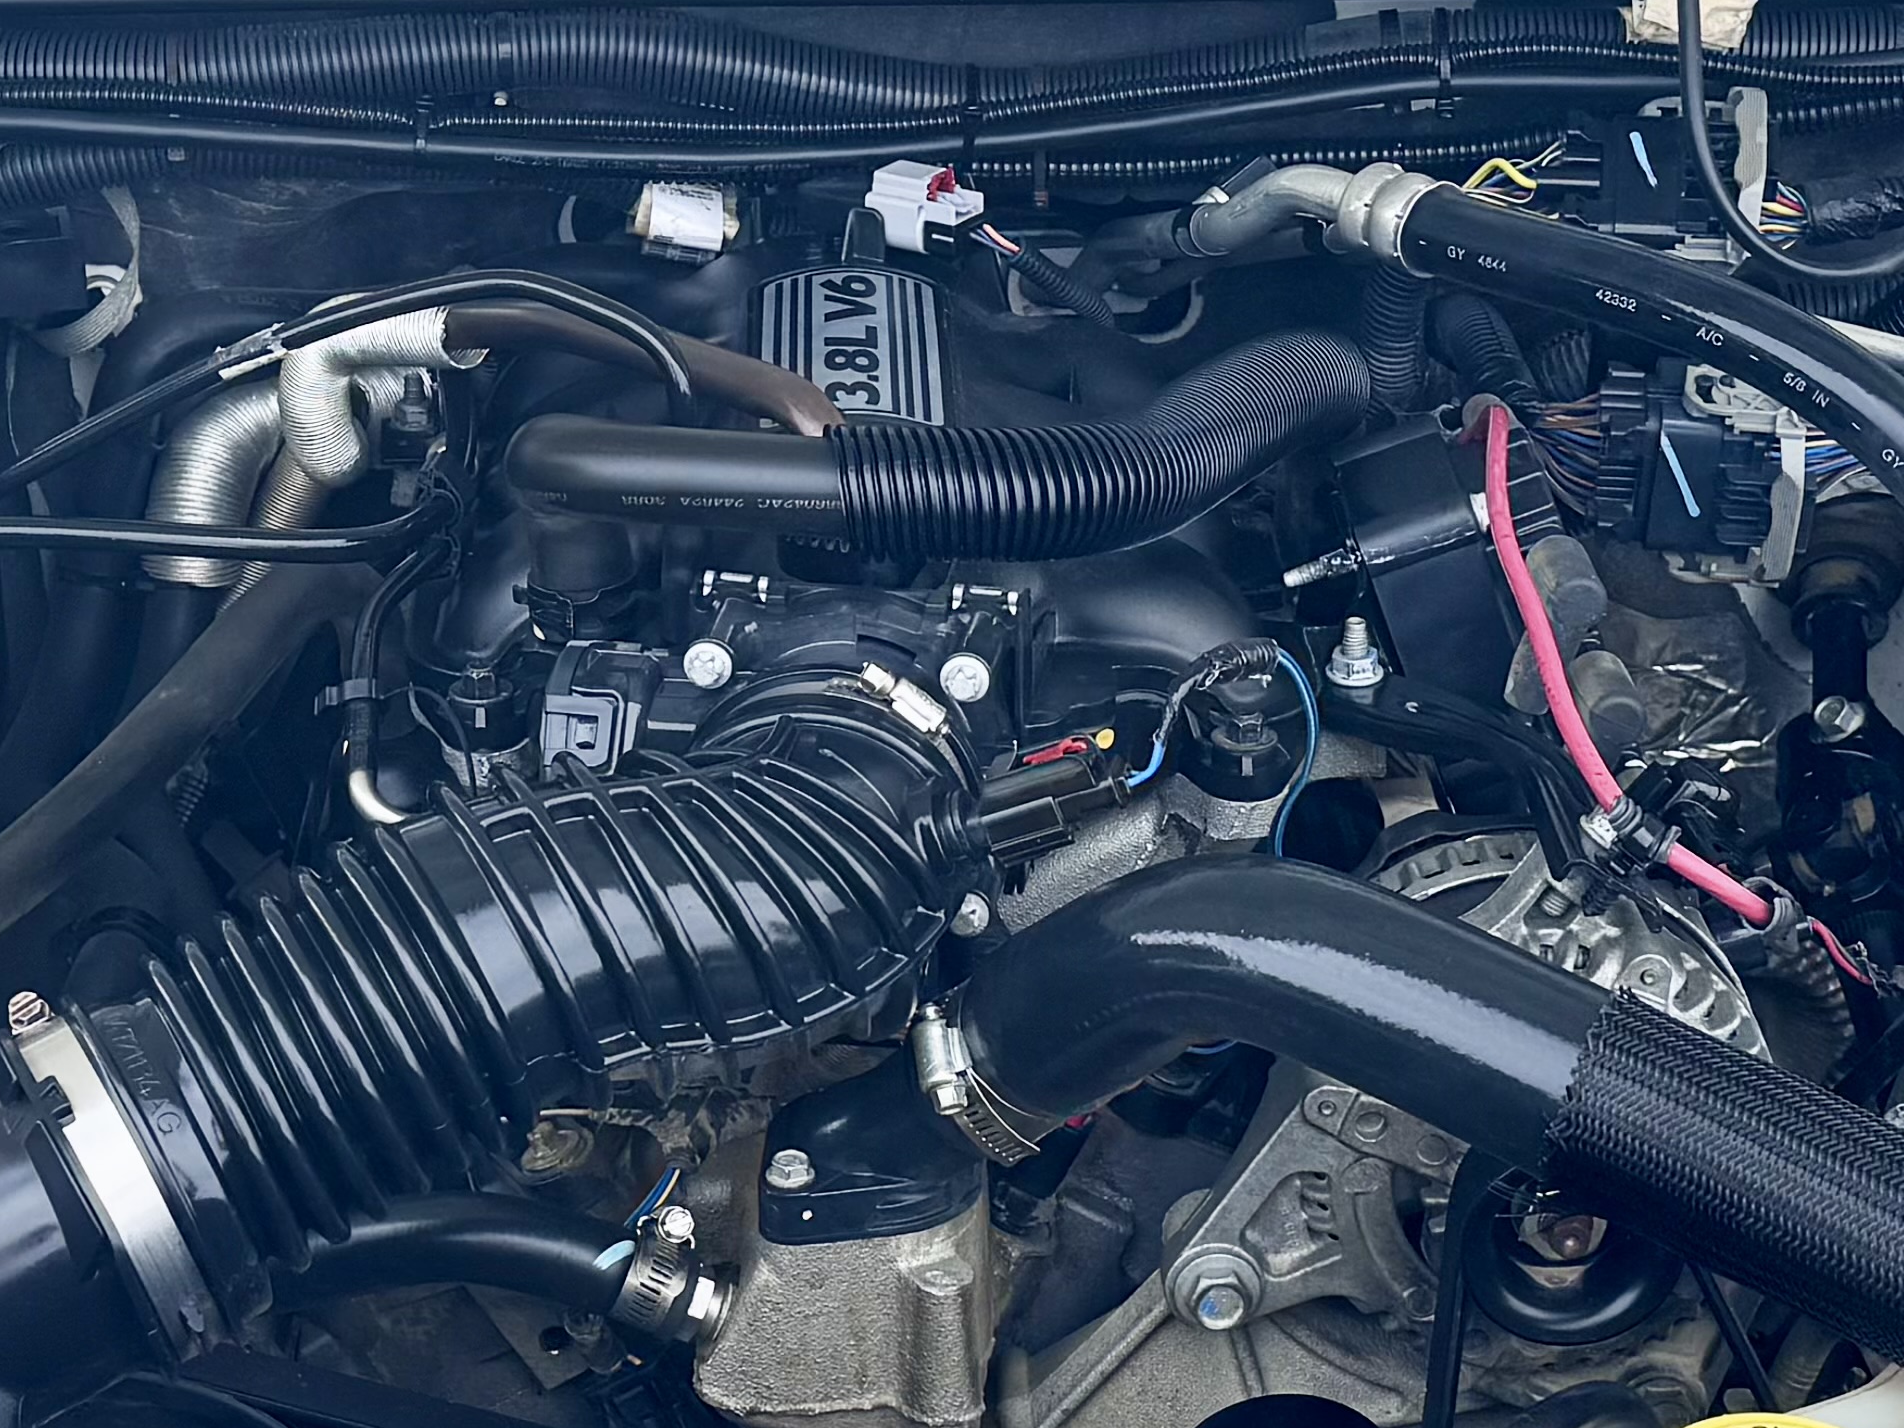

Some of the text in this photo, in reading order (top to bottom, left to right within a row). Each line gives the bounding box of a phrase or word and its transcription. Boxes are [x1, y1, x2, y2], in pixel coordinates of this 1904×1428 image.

[1447, 245, 1466, 261] GY
[1696, 327, 1724, 347] A/C
[1810, 387, 1831, 408] IN
